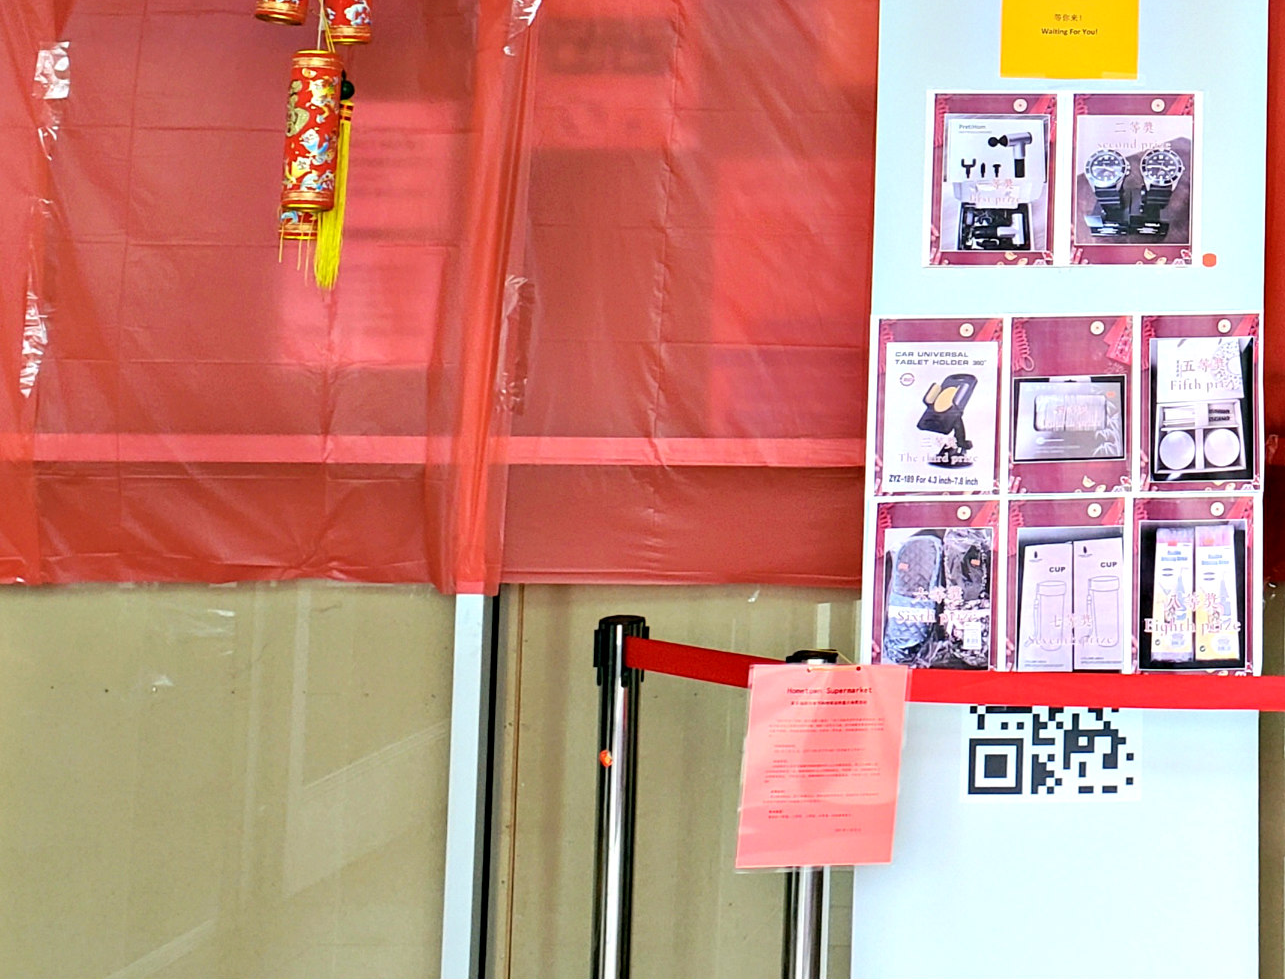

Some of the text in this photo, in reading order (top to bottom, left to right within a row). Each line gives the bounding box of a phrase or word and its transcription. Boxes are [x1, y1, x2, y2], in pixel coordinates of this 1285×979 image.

[1041, 27, 1068, 36] Waiting
[1082, 28, 1098, 36] You!
[1097, 138, 1138, 149] second
[1170, 377, 1202, 391] Fifth
[899, 452, 918, 463] The
[915, 475, 926, 483] For
[965, 476, 979, 486] inch
[896, 609, 937, 624] Sixth
[1143, 618, 1196, 636] Eighth
[825, 686, 873, 695] Supermarket
